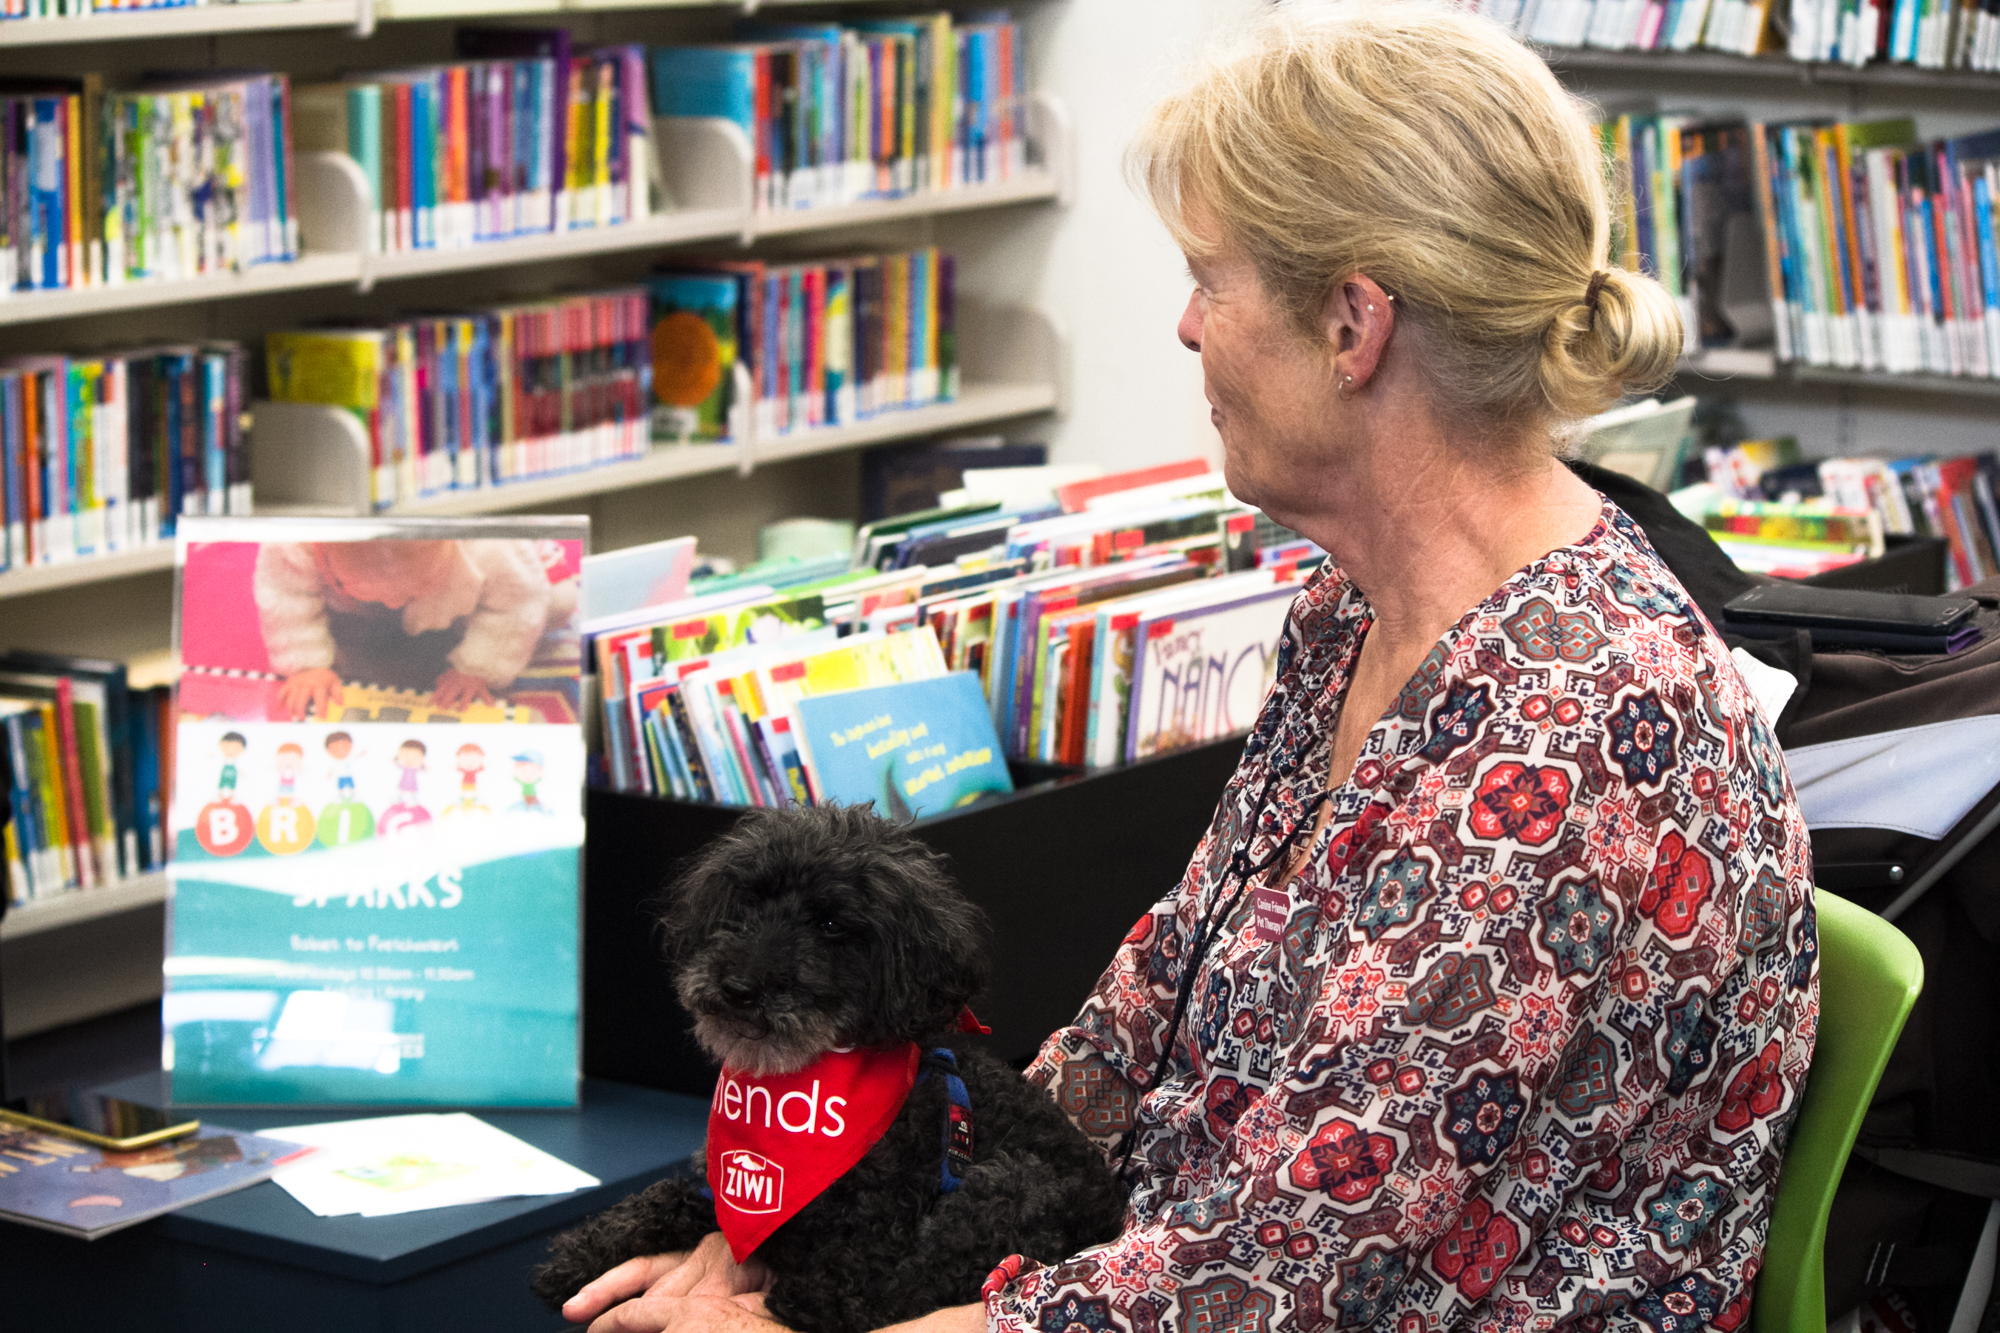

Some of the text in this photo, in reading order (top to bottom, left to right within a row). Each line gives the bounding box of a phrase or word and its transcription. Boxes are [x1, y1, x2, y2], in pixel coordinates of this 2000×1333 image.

[1156, 638, 1280, 741] NANCY
[292, 866, 463, 909] ARKS
[1257, 898, 1288, 916] Canine Friends
[725, 1166, 773, 1205] ZIWI
